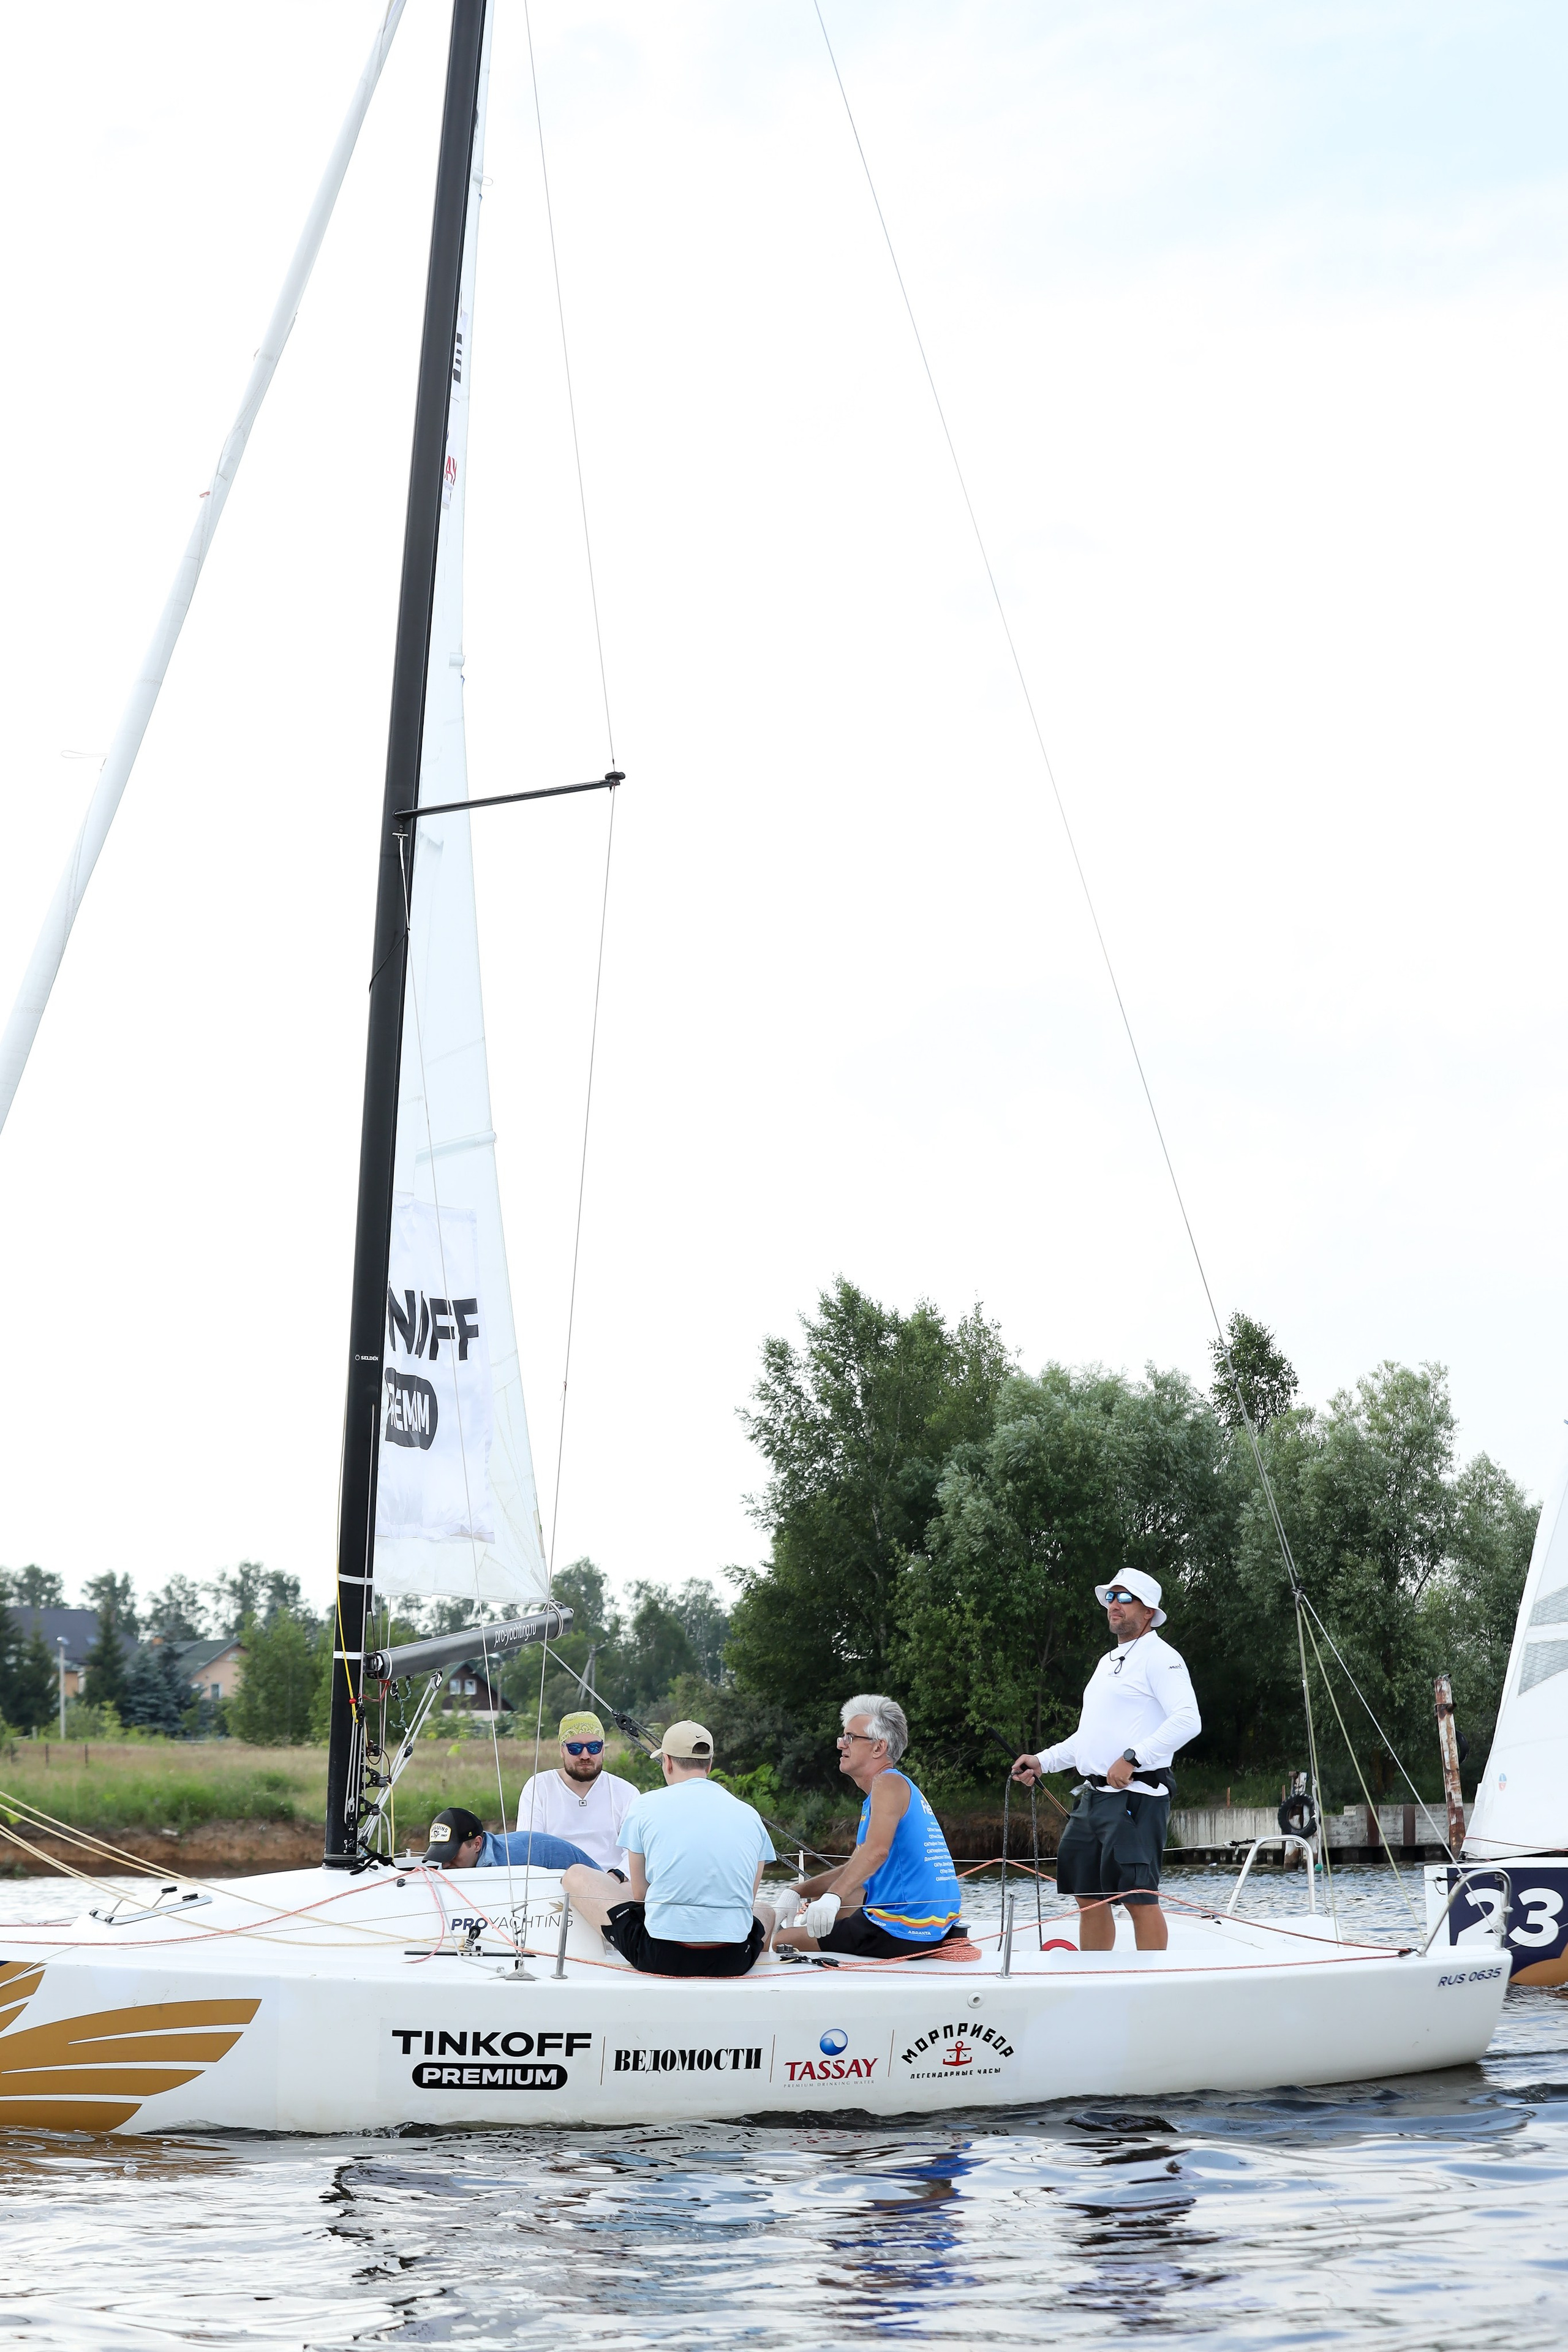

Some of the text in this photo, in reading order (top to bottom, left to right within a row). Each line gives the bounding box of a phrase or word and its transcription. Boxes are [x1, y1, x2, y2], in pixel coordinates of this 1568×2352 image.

[494, 1622, 537, 1648] pro-yachting.ru
[1456, 1887, 1564, 1948] 23
[1438, 1967, 1502, 1987] RUS 0635
[392, 2030, 592, 2057] TINKOFF
[901, 2022, 1014, 2064] МОРПРИБОР
[613, 2048, 763, 2074] ВЕДОМОСТИ
[784, 2058, 879, 2081] TASSAY
[422, 2067, 557, 2086] PREMIUM
[910, 2070, 973, 2079] ЛЕГЕНДАРНЫЕ
